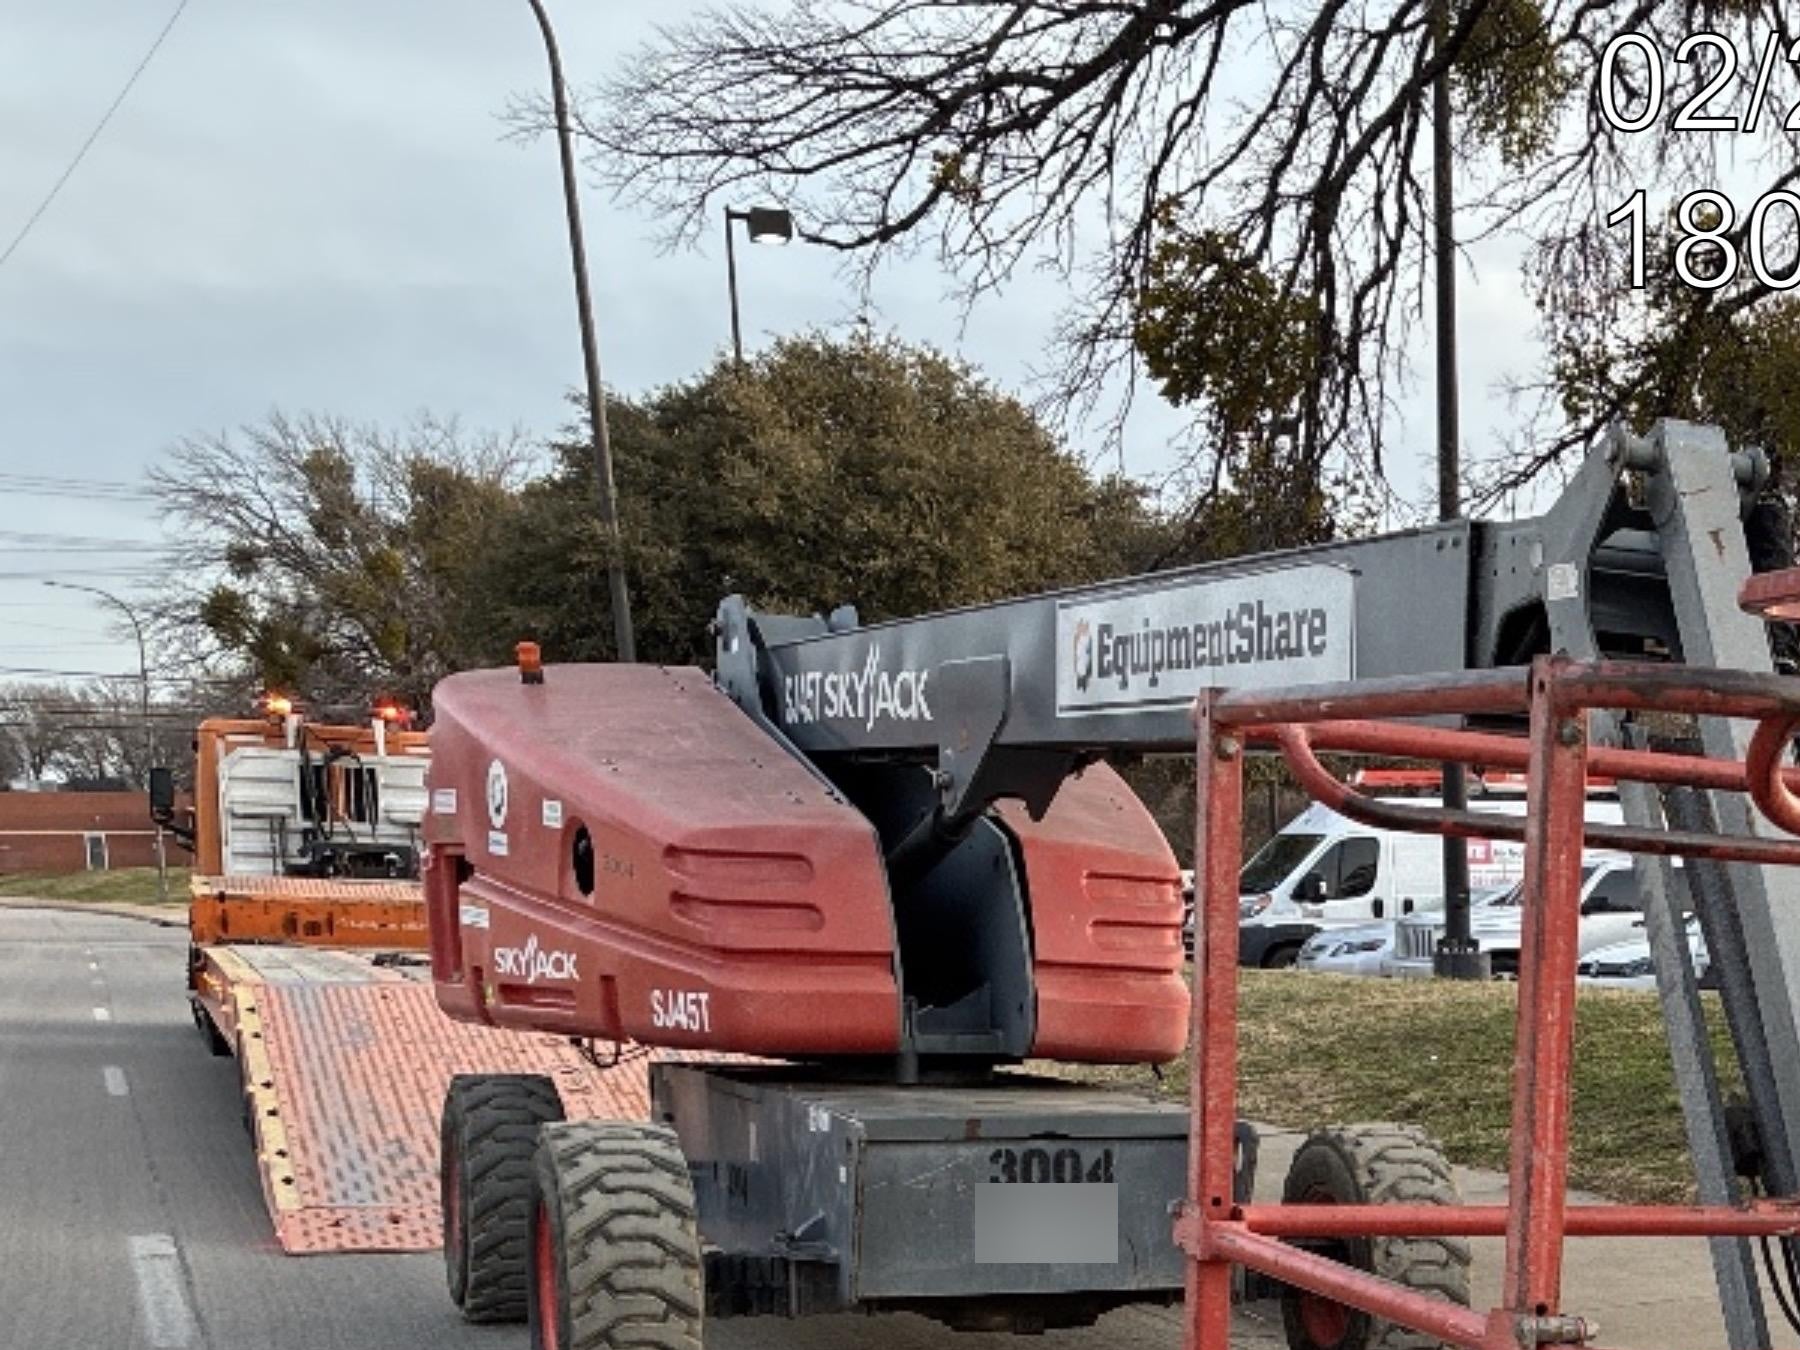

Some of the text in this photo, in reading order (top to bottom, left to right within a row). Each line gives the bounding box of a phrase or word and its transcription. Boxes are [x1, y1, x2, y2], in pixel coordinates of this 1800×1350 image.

[1097, 600, 1327, 690] EquipmentShare
[824, 642, 933, 732] SKYJACK
[494, 933, 580, 983] SKYJACK
[650, 989, 711, 1032] SJ45T
[990, 1149, 1114, 1183] 3004
